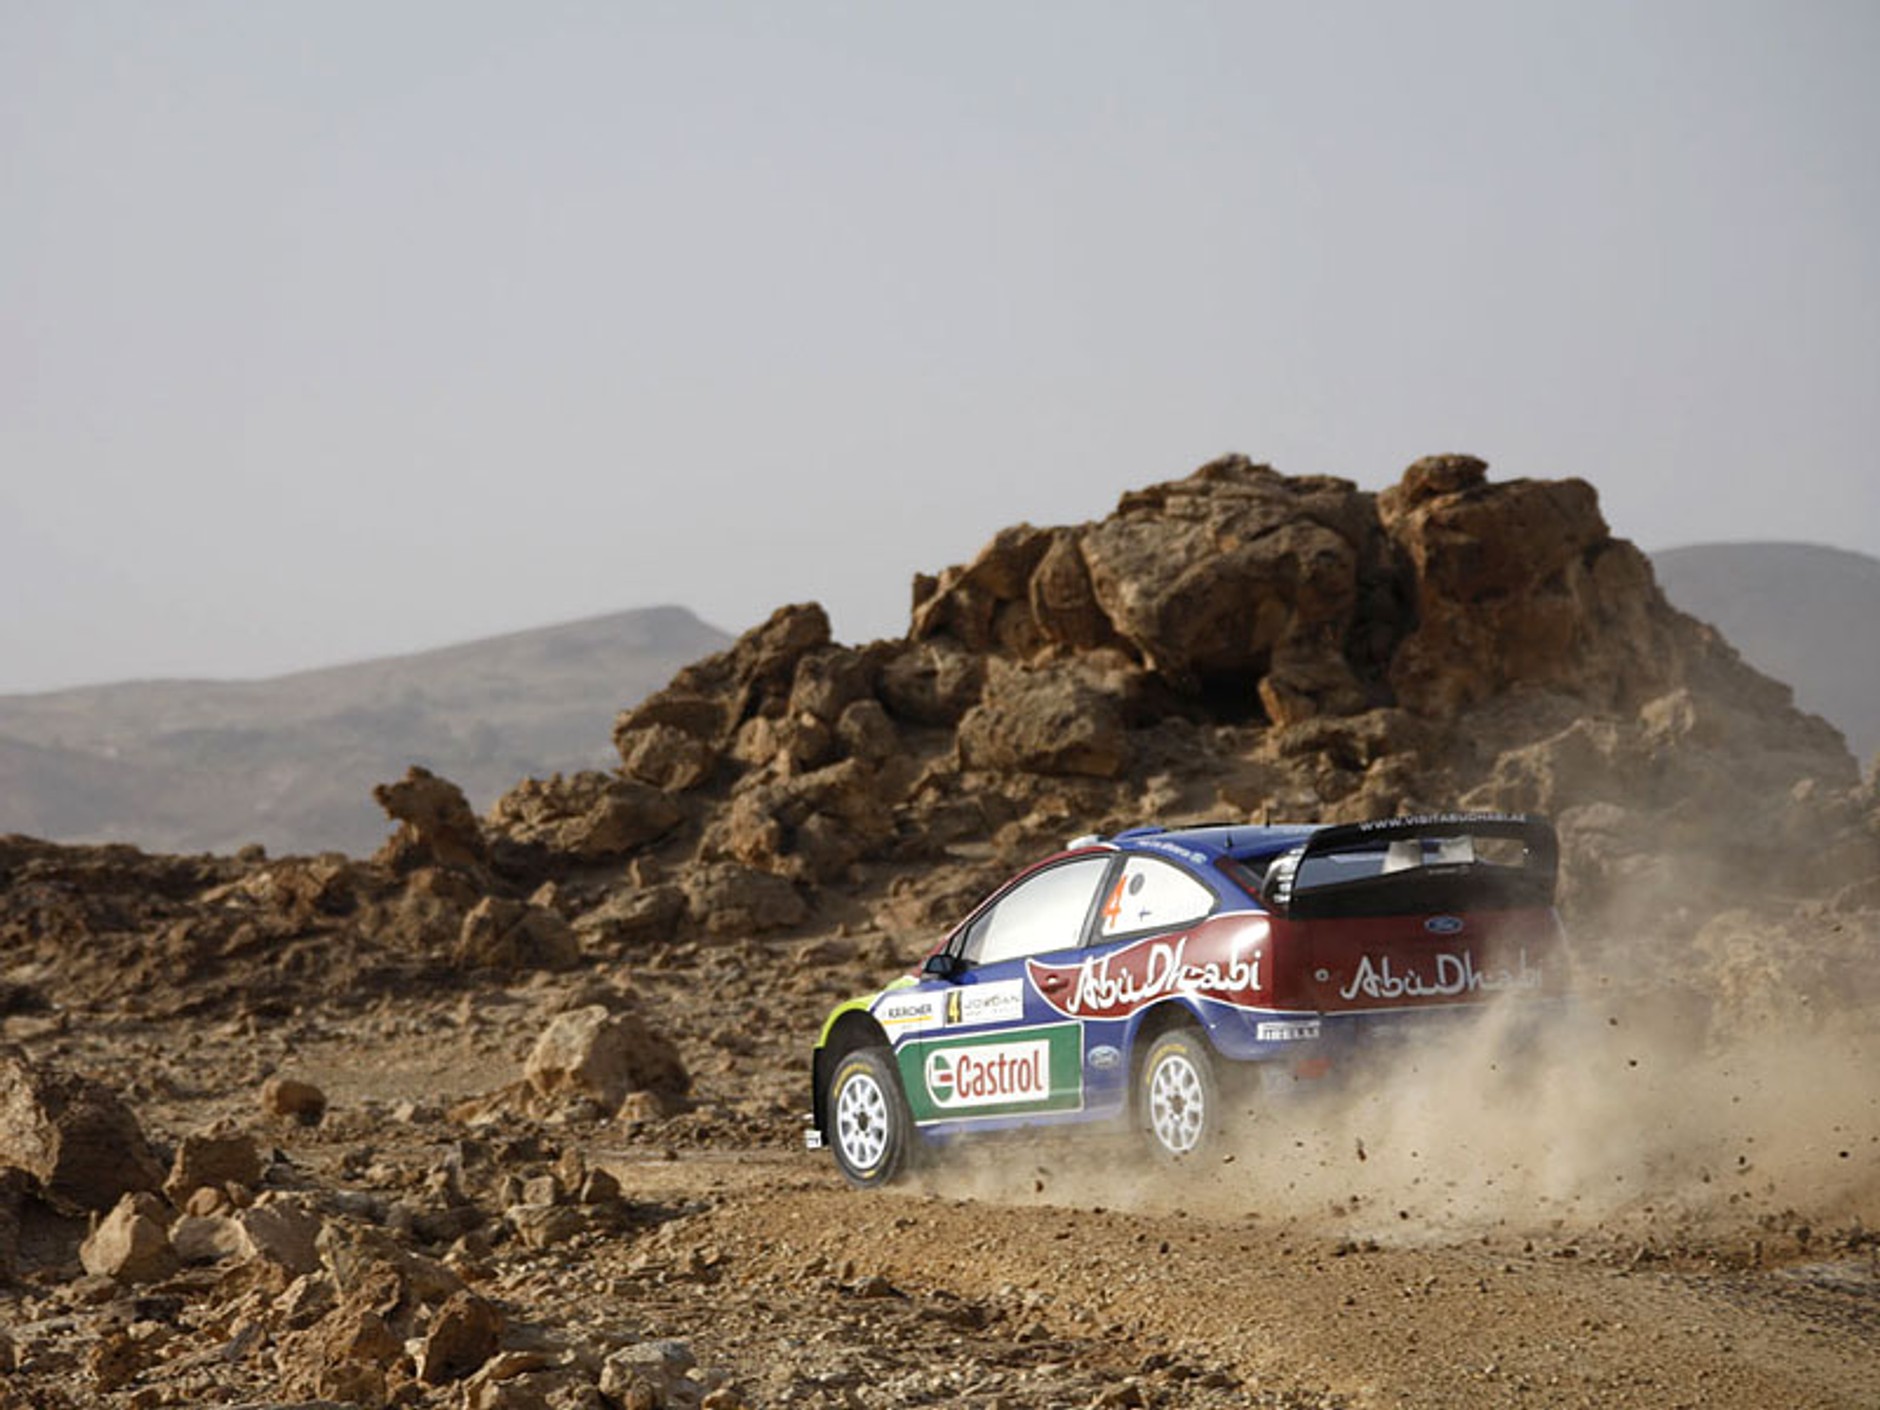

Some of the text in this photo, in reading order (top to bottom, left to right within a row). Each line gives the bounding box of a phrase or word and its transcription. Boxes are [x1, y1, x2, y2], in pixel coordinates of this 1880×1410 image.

[1102, 874, 1128, 929] 4
[948, 990, 961, 1023] 4
[956, 1049, 1044, 1099] Castrol
